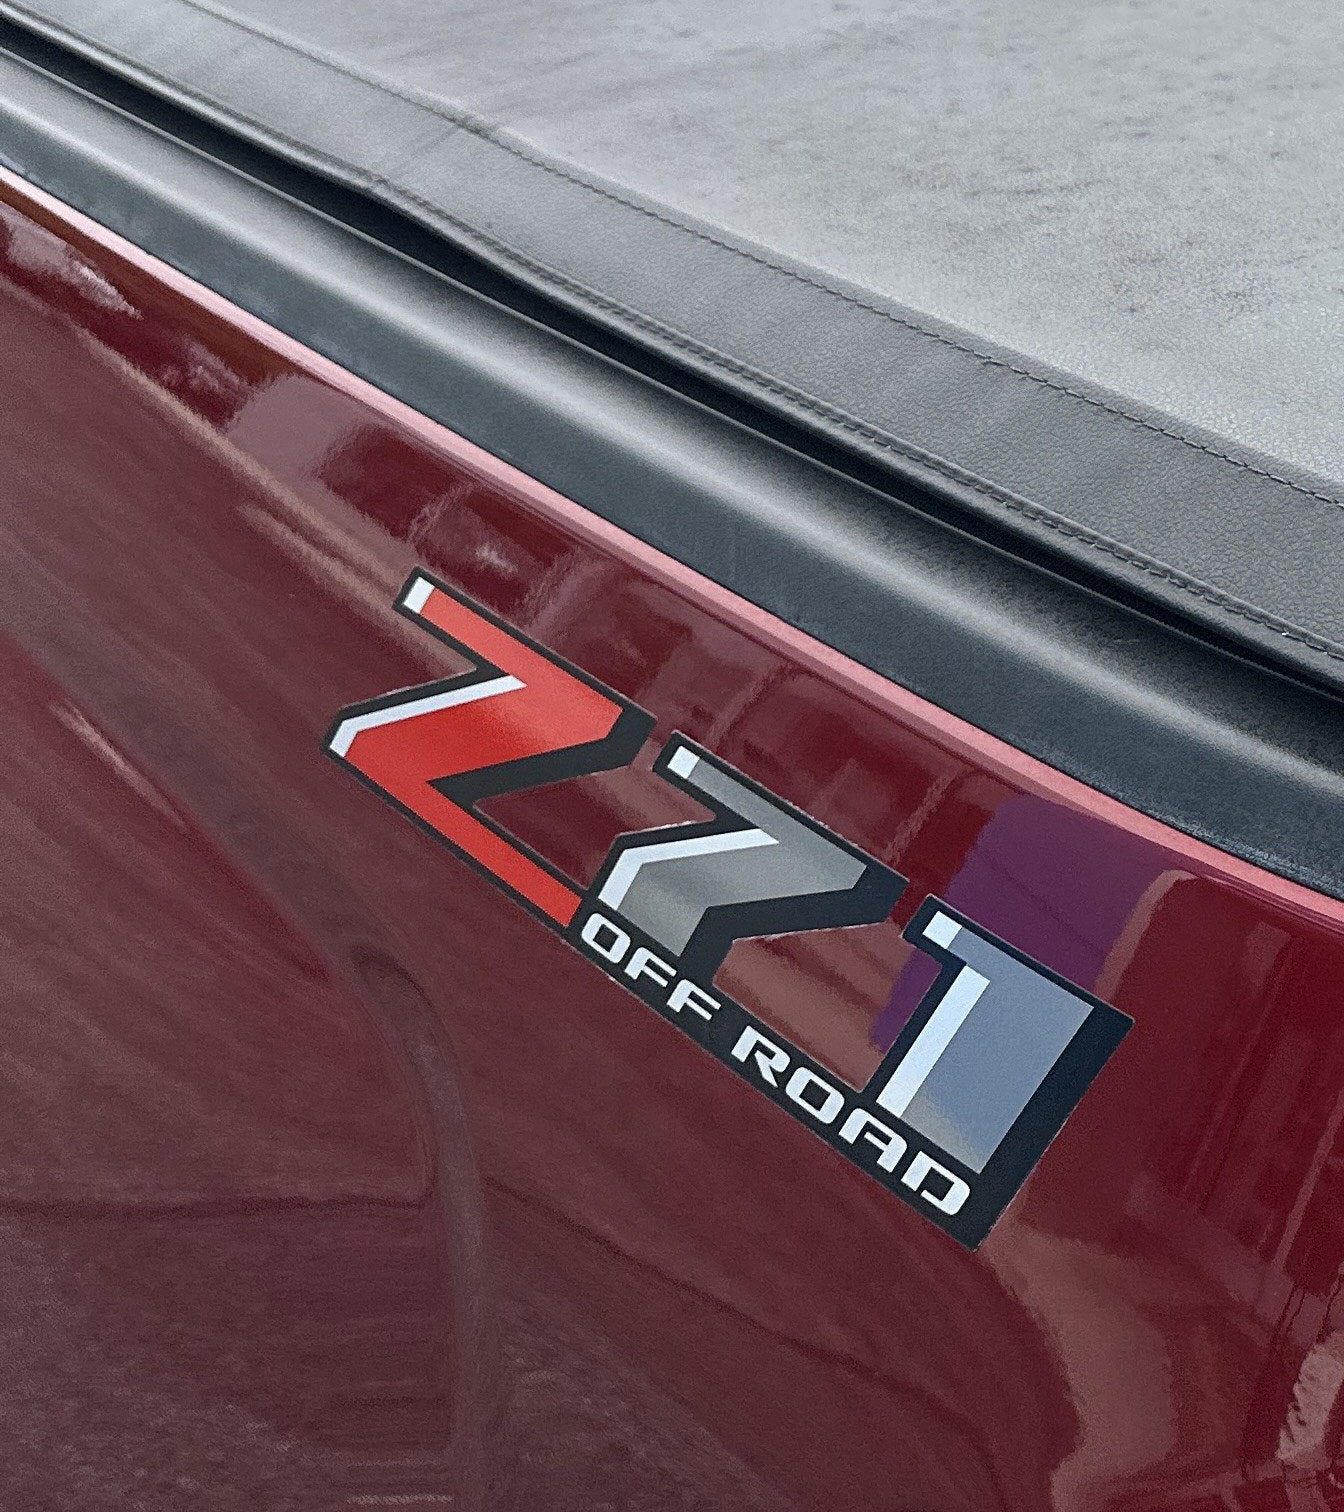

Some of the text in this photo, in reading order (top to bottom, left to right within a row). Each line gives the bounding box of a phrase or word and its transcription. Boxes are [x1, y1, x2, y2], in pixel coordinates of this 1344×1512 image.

[329, 575, 1096, 1176] Z71
[580, 912, 973, 1218] OFF ROAD
